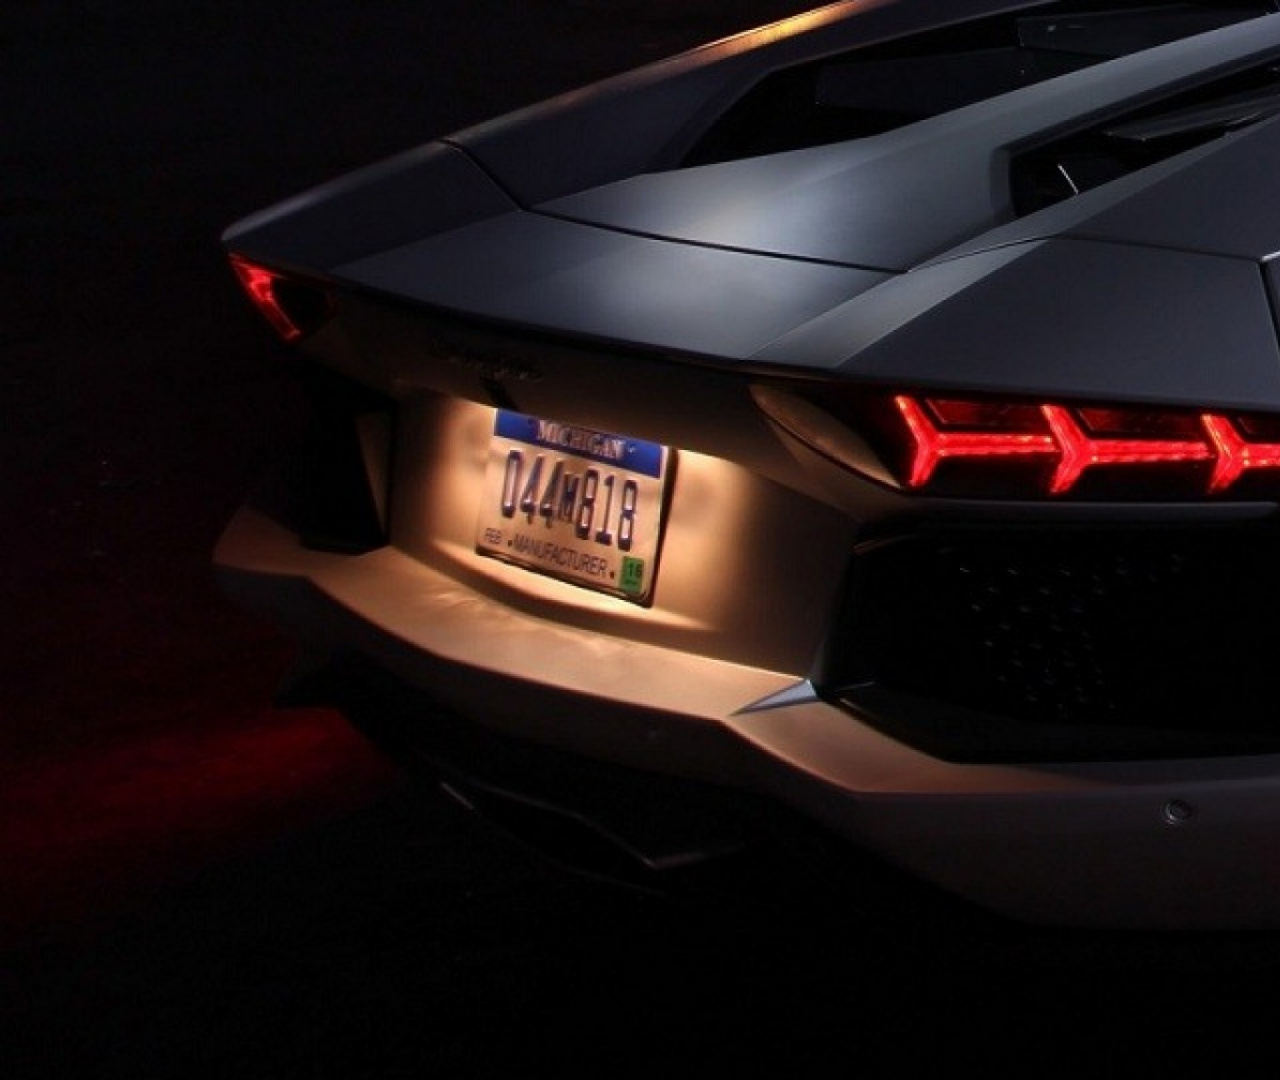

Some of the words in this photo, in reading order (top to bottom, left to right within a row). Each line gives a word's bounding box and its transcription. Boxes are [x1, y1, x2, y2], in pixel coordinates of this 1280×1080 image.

[537, 419, 626, 460] MICHIGAN
[501, 449, 638, 552] 044M818
[513, 534, 608, 576] MANUFACTURER
